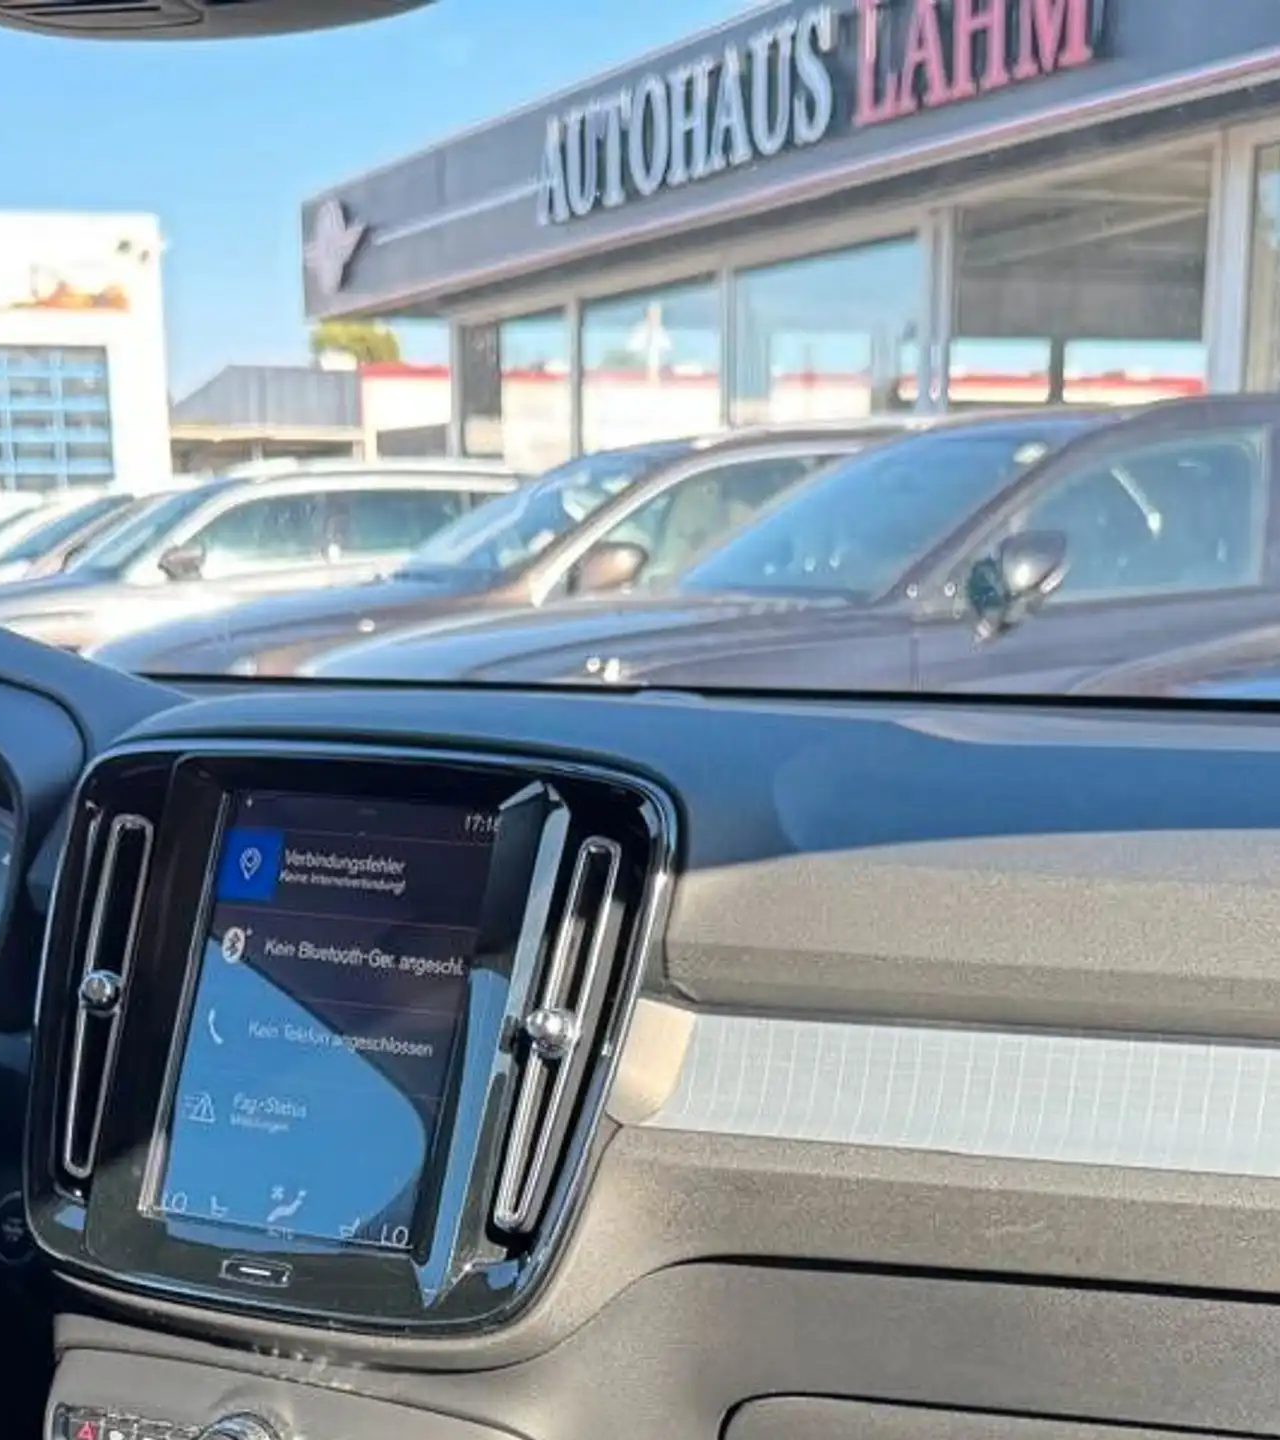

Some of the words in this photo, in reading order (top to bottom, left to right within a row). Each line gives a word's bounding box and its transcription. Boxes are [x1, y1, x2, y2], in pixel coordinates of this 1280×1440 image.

[535, 9, 835, 226] AUTOHAUS
[853, 0, 1094, 127] LAHM
[284, 848, 407, 876] Verbindungsfehler
[264, 938, 296, 957] Kein
[248, 1019, 280, 1039] Kein
